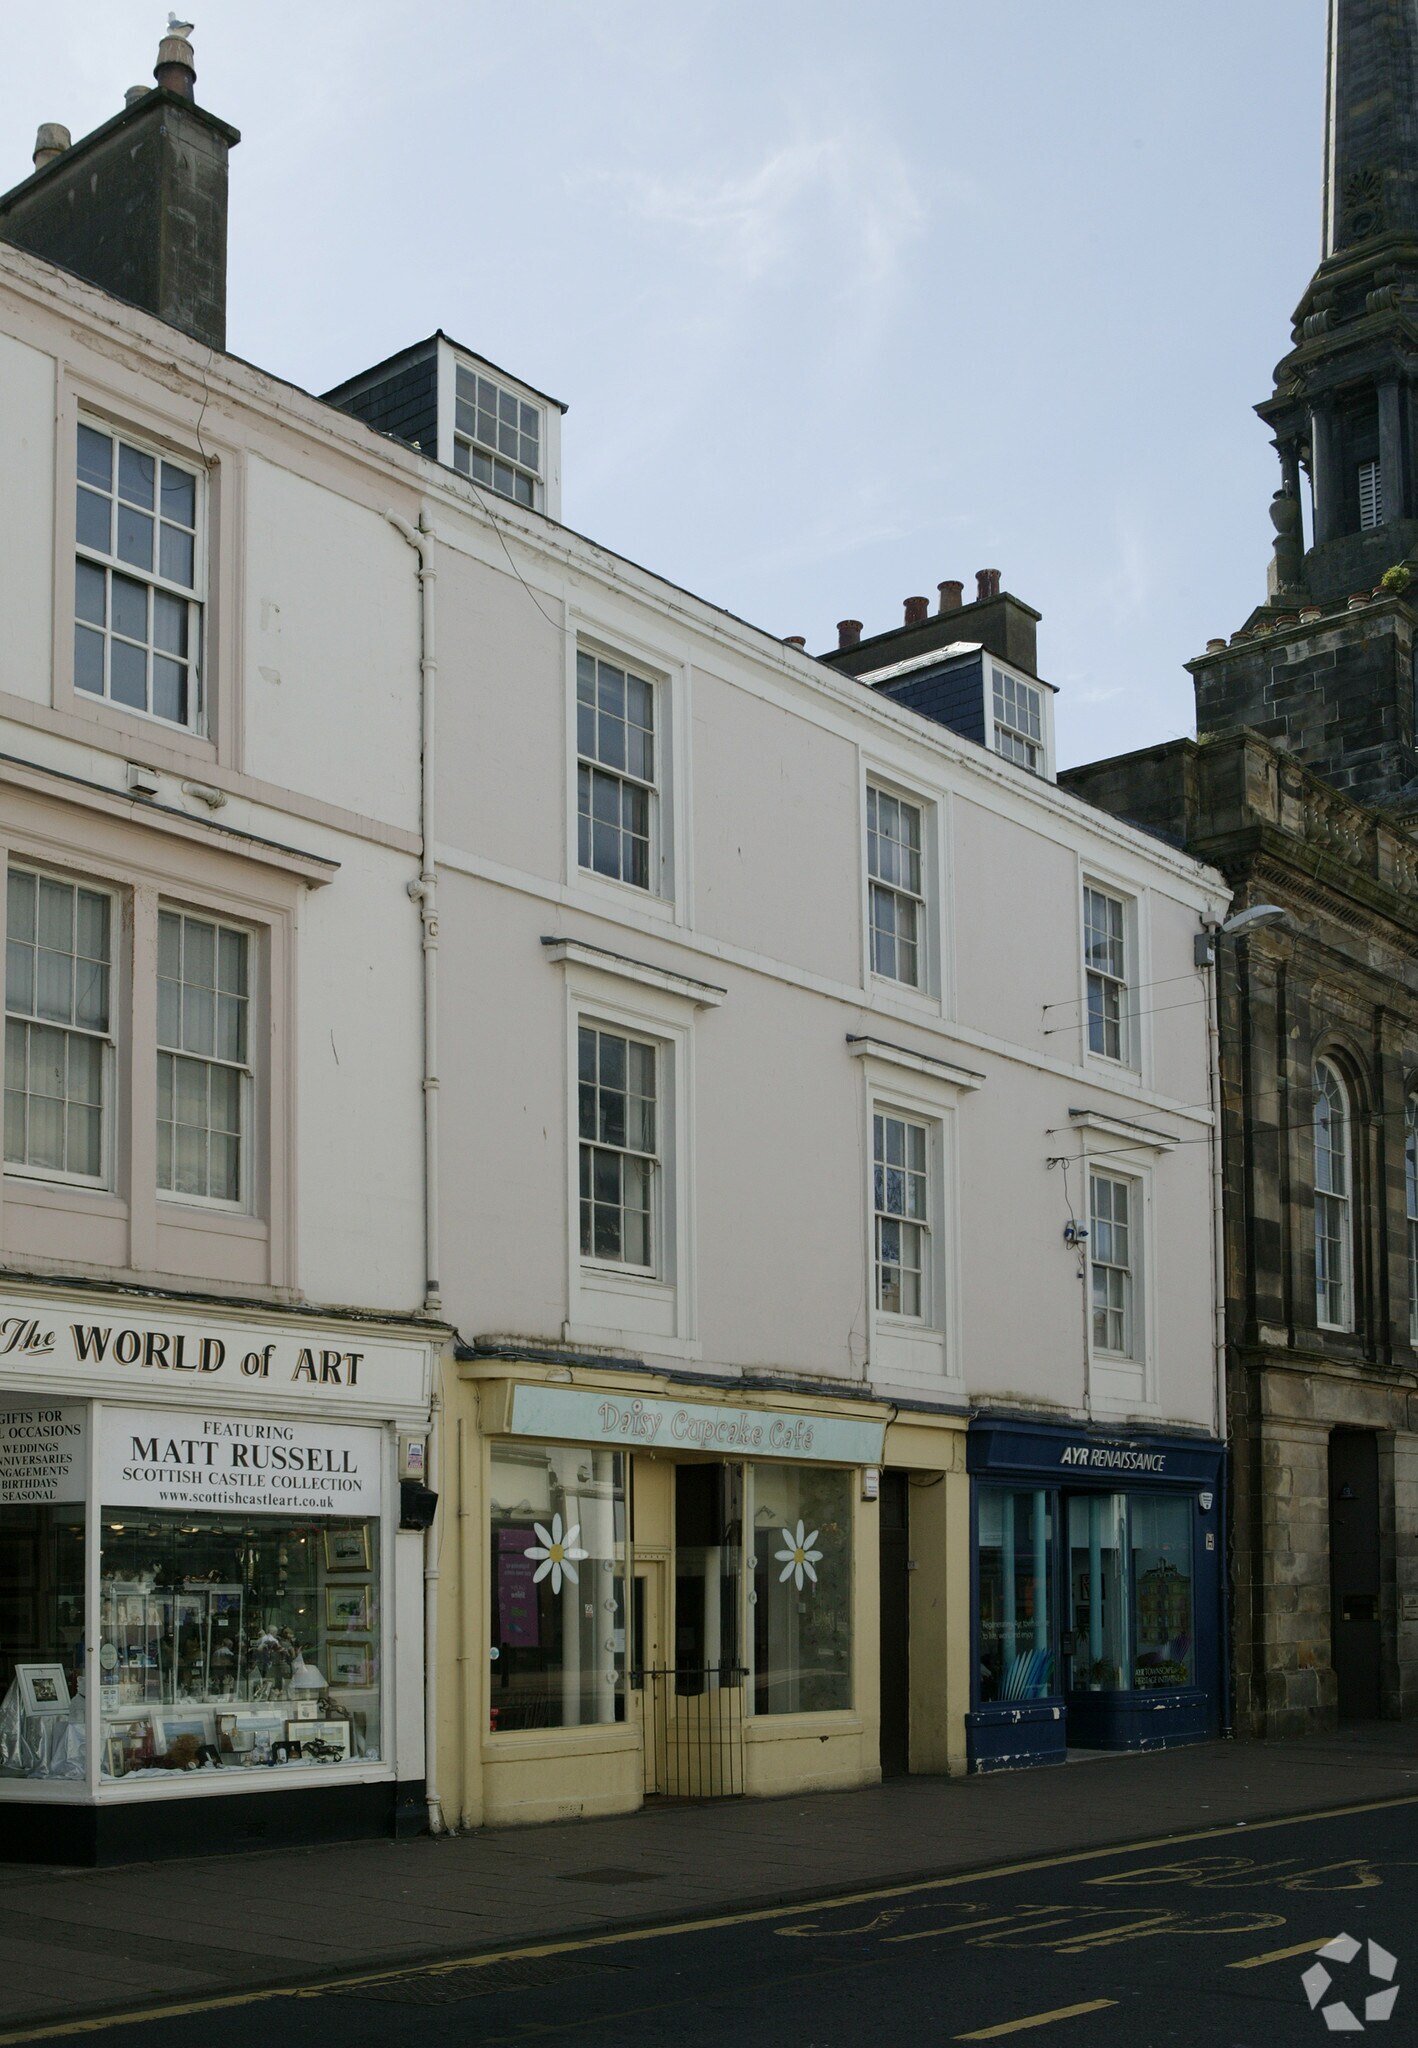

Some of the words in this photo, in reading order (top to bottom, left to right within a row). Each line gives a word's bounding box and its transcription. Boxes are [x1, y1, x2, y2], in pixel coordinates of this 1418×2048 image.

[0, 1317, 57, 1356] The
[70, 1323, 226, 1373] WORLD
[240, 1344, 277, 1379] of
[291, 1348, 364, 1386] ART
[38, 1410, 62, 1423] FOR
[598, 1399, 663, 1442] Daisy
[671, 1409, 763, 1448] Cupcake
[769, 1419, 814, 1451] Café
[8, 1424, 81, 1439] OCCASIONS
[203, 1421, 295, 1441] FEATURING
[2, 1442, 59, 1454] WEDDINGS
[130, 1435, 219, 1466] MATT
[231, 1443, 358, 1474] RUSSELL
[1061, 1446, 1090, 1466] AYR
[1090, 1449, 1166, 1472] RENAISSANCE
[2, 1478, 58, 1490] BIRTHDAYS
[122, 1467, 202, 1484] SCOTTISH
[208, 1472, 266, 1488] CASTLE
[271, 1475, 363, 1492] COLLECTION
[2, 1490, 56, 1501] SEASONAL
[158, 1491, 334, 1508] www.scottishcastleart.co.uk
[1080, 1856, 1418, 1891] BUS
[773, 1902, 1287, 1954] STOP
